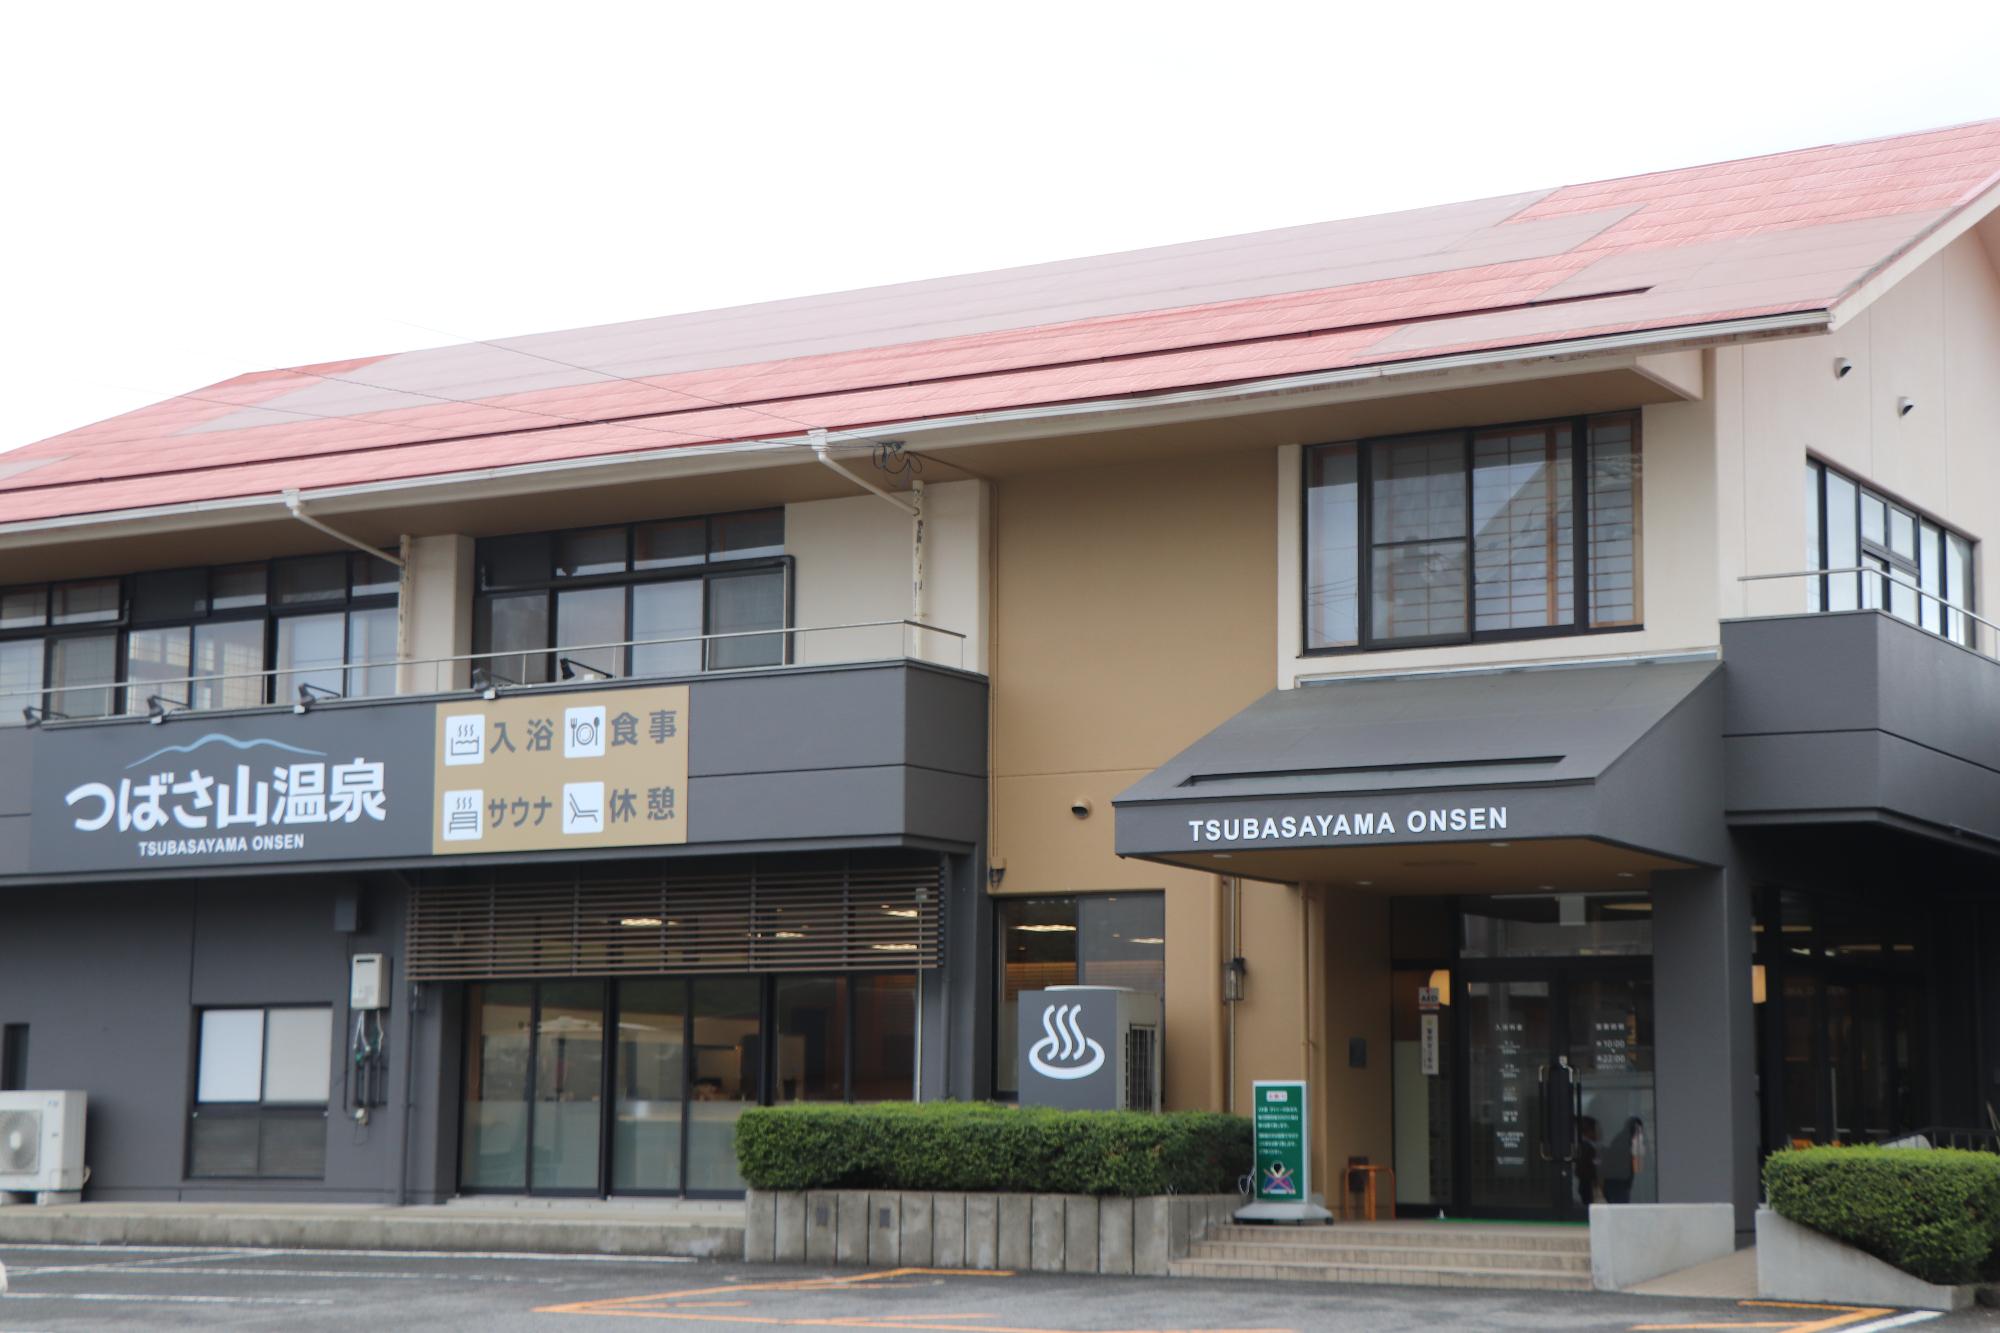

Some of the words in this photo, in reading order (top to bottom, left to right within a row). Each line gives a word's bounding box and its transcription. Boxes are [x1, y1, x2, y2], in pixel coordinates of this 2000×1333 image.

[489, 718, 554, 754] 入浴
[611, 709, 677, 746] 食事
[65, 757, 386, 832] つばさ山温泉
[488, 796, 552, 828] サウナ
[609, 786, 675, 824] 休憩
[1188, 812, 1396, 841] TSUBASAYAMA
[1406, 807, 1507, 833] ONSEN
[139, 837, 248, 857] TSUBASAYAMA
[252, 833, 304, 851] ONSEN
